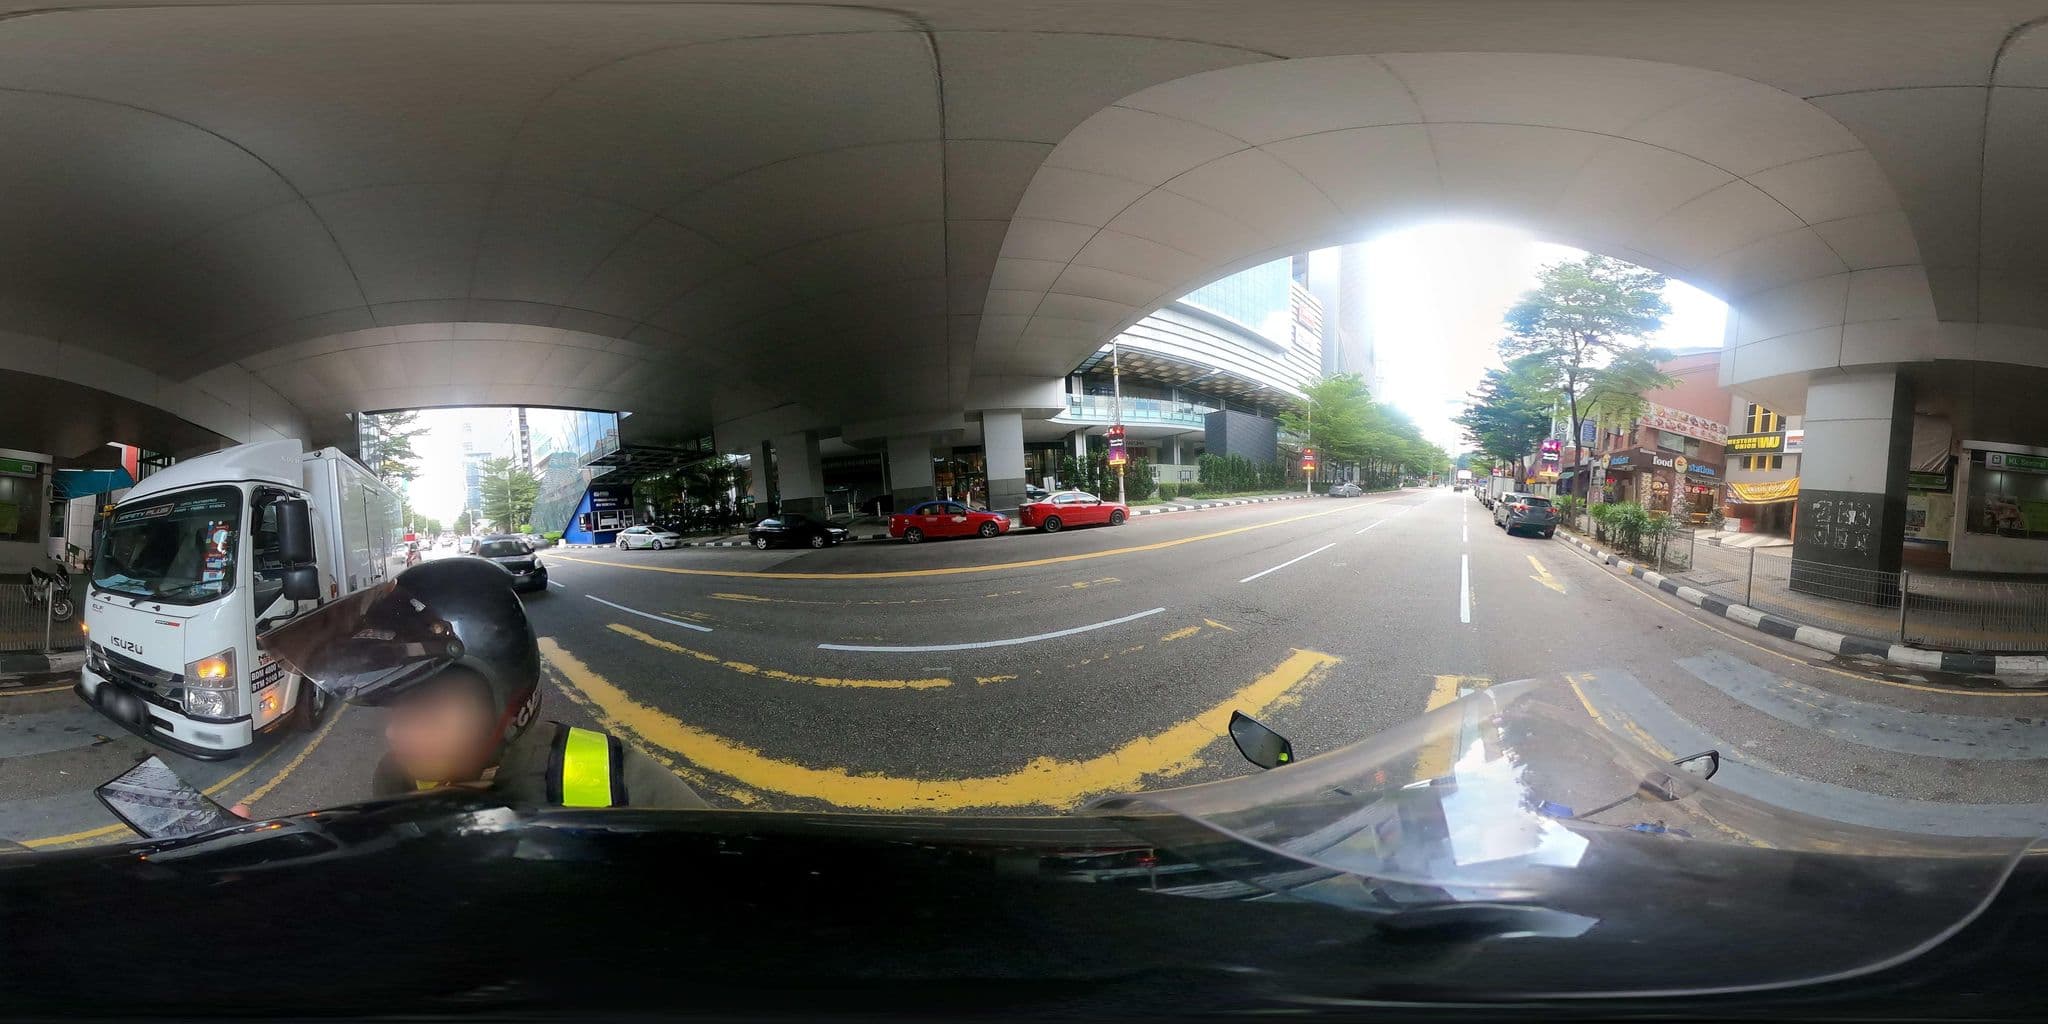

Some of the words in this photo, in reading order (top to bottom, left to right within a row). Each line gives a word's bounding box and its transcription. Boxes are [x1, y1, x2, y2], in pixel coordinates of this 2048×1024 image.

[1652, 455, 1673, 468] food
[1688, 463, 1715, 476] station
[110, 635, 143, 655] ISUZU
